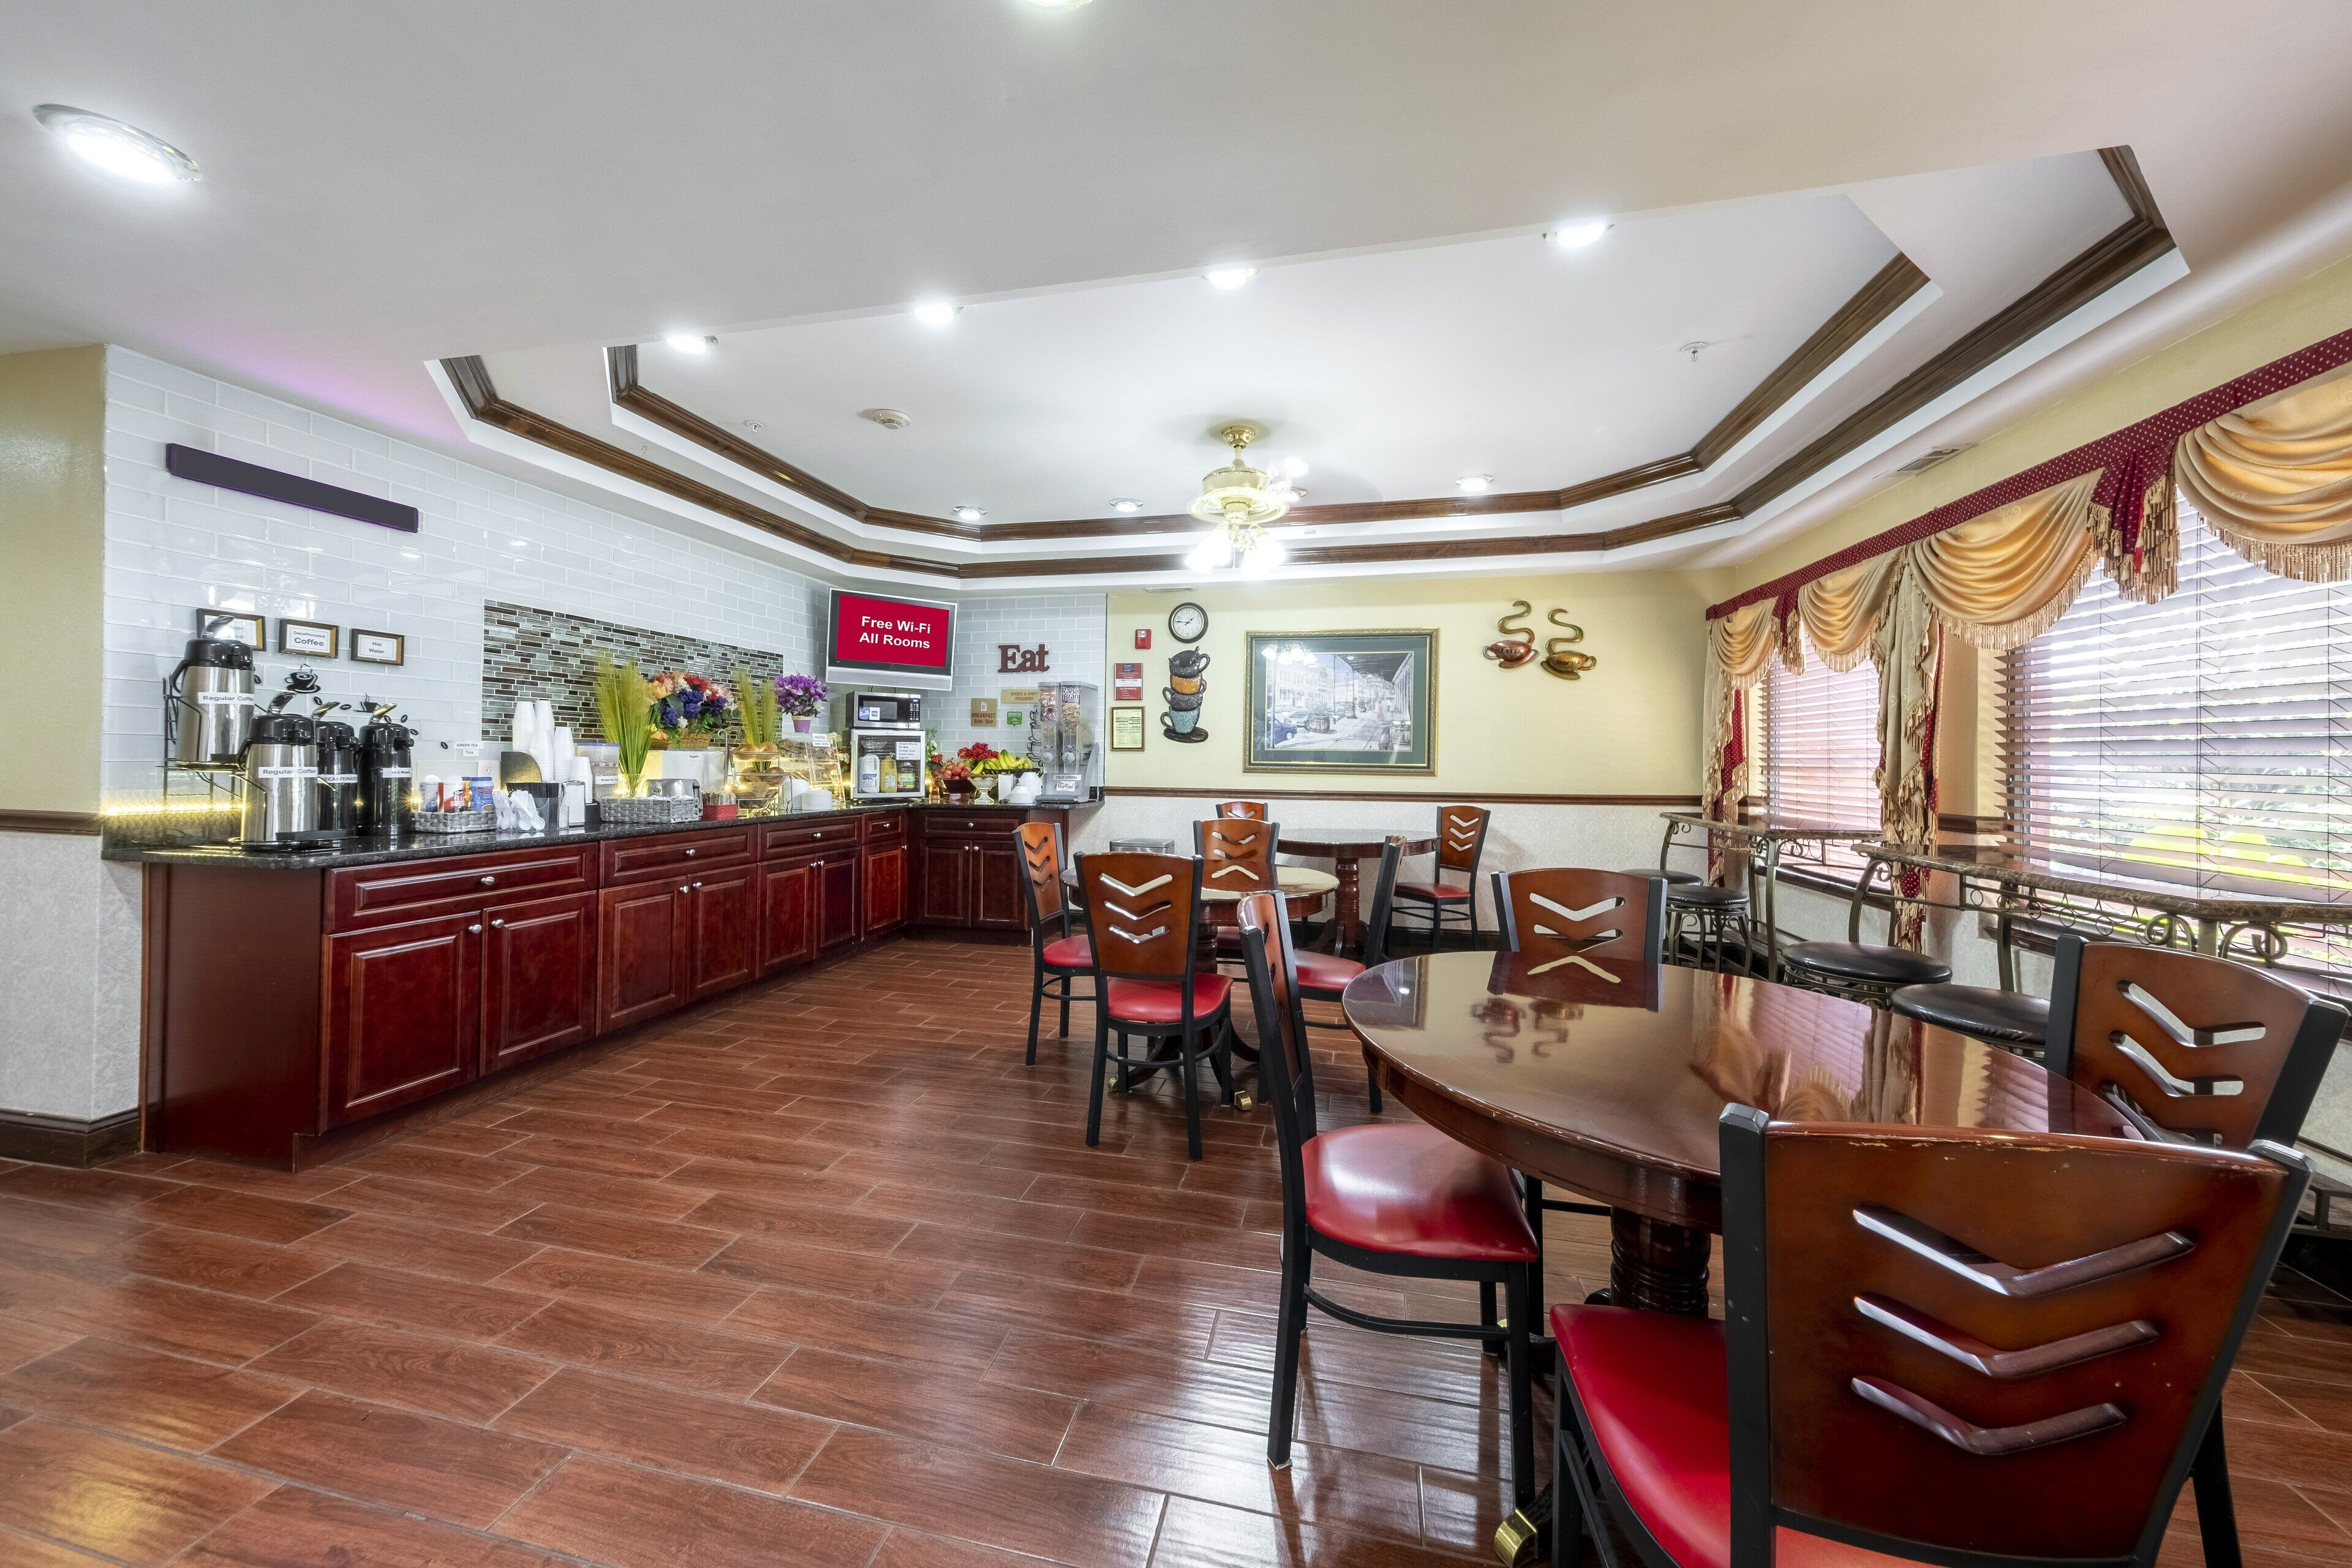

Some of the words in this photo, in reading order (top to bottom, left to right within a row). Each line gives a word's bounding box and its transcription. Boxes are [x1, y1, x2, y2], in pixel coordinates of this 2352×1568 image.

[861, 616, 892, 630] Free
[897, 620, 931, 634] Wi-Fi
[294, 637, 324, 647] Coffee
[859, 632, 878, 644] All
[883, 634, 930, 649] Rooms
[998, 644, 1050, 673] Eat
